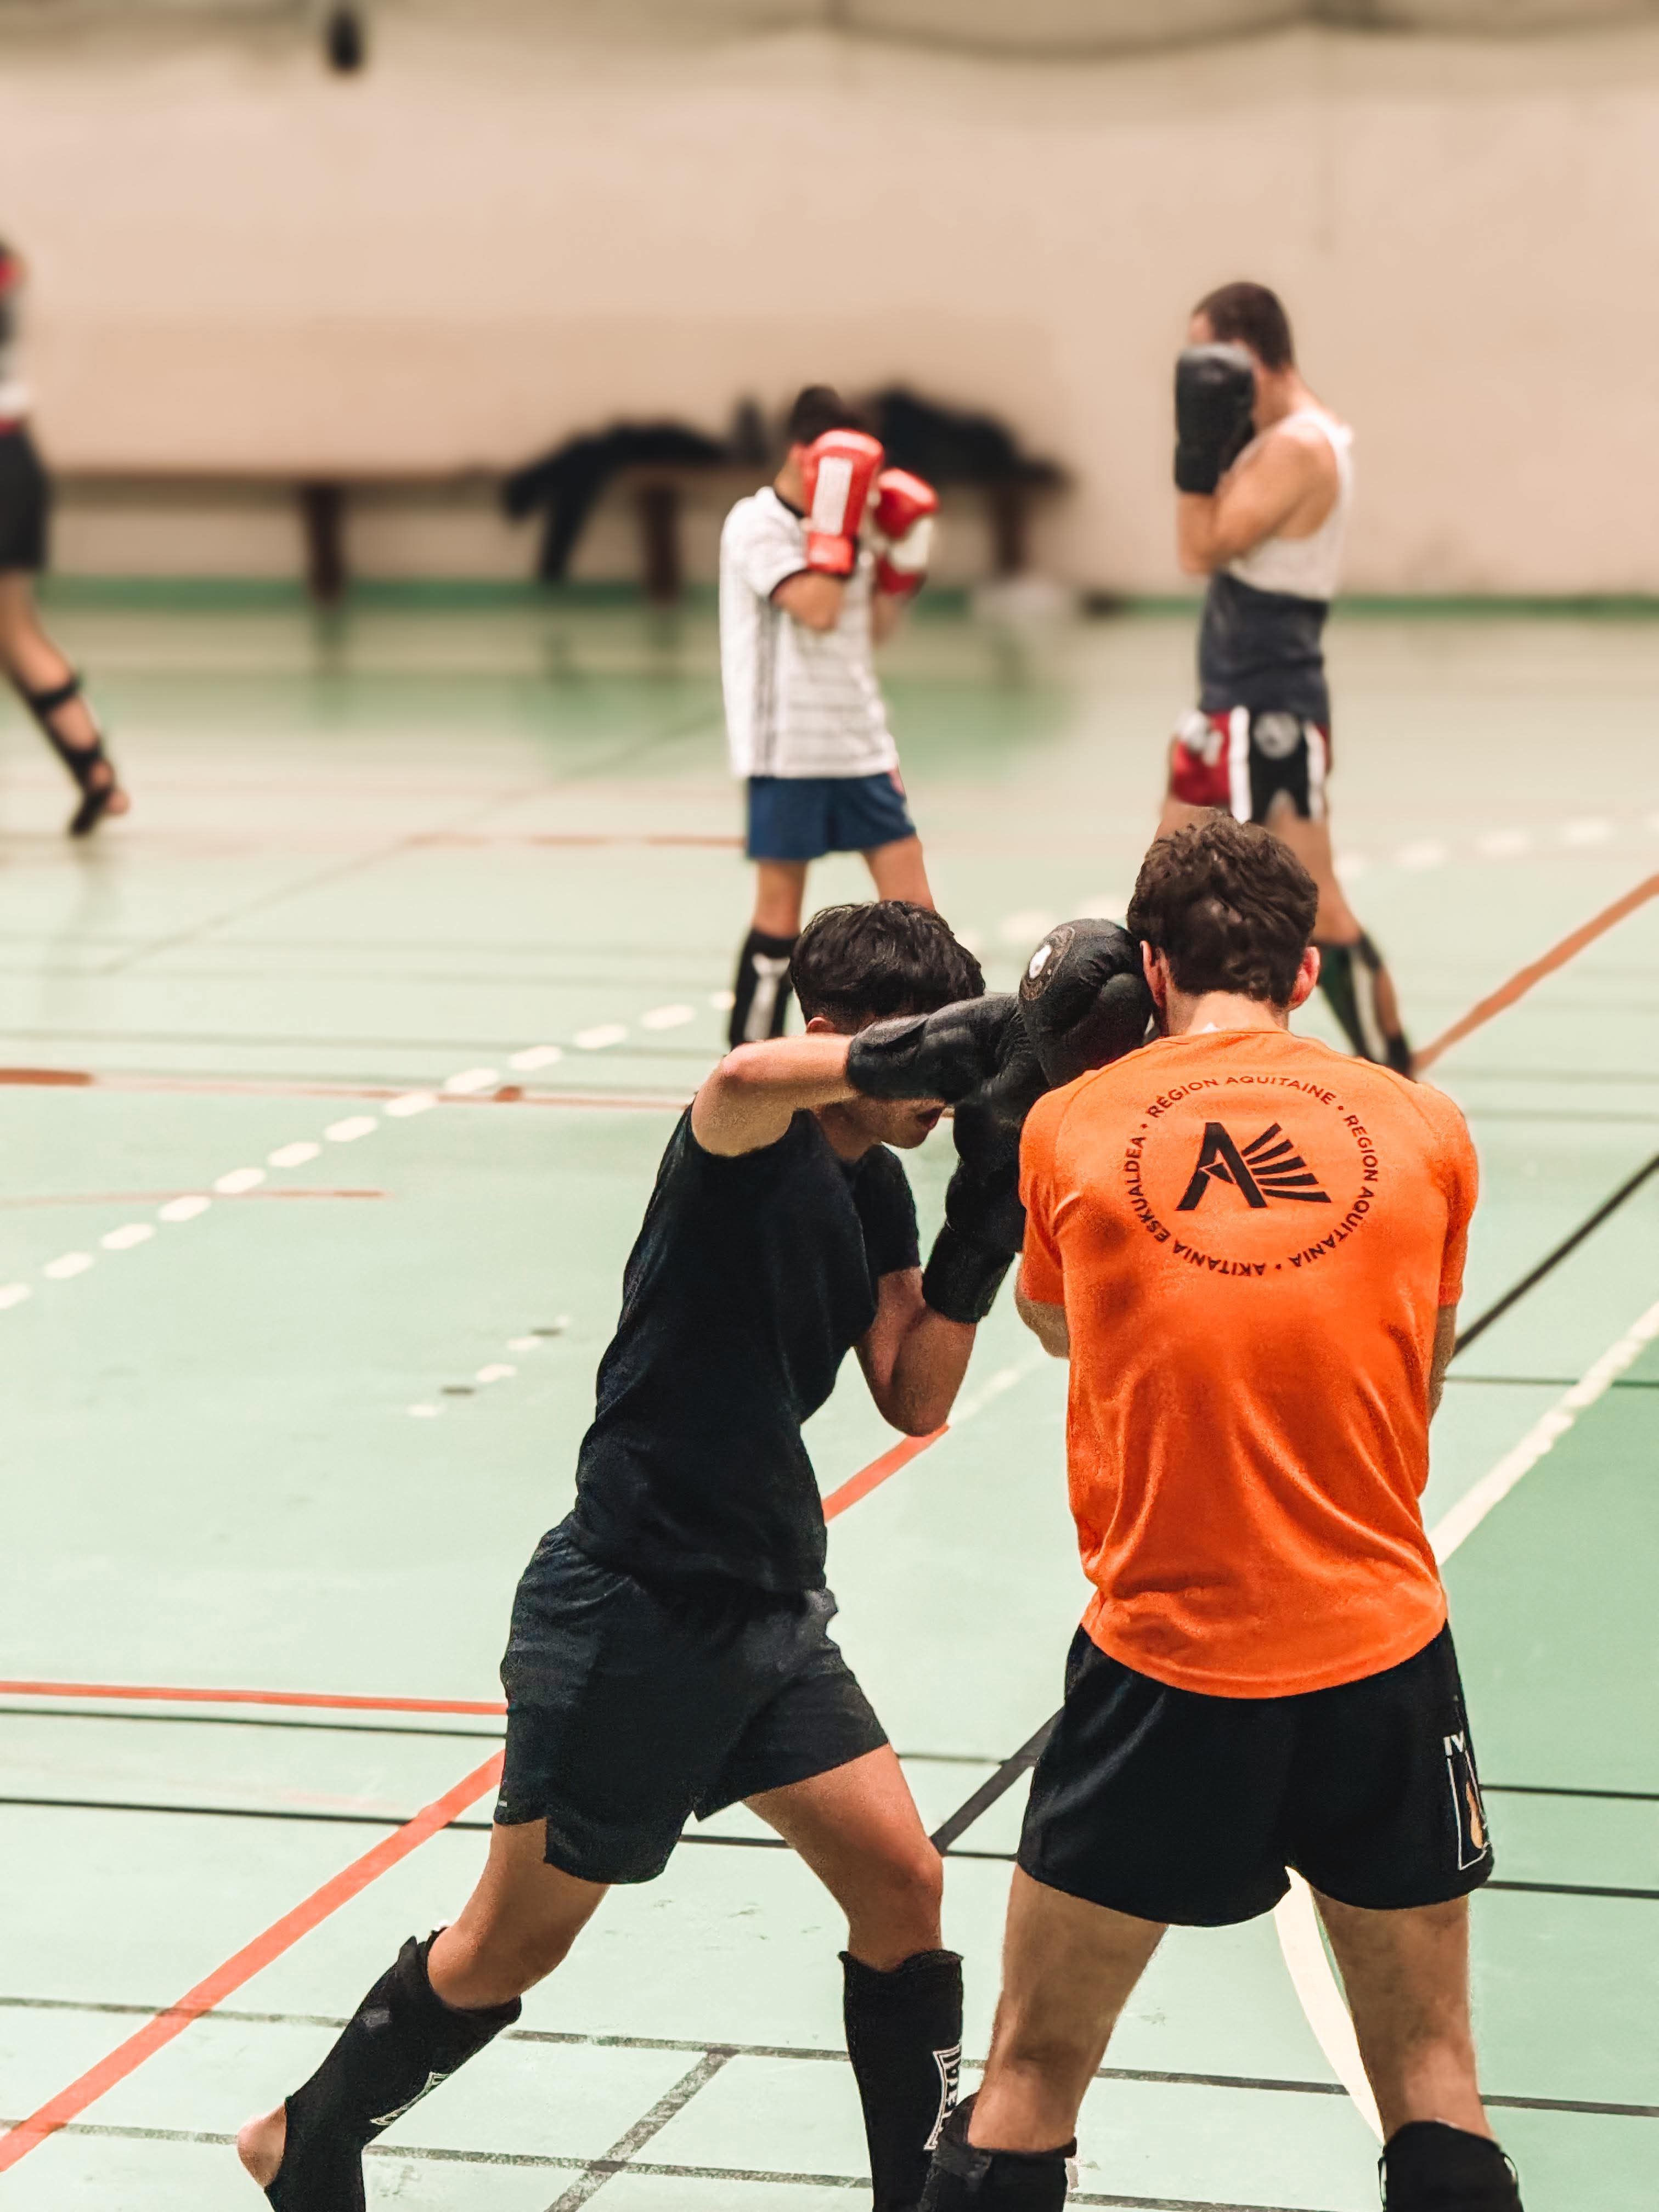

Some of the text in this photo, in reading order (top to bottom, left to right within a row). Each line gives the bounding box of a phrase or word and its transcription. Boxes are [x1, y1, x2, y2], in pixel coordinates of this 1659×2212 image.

[1226, 1076, 1337, 1105] AQUITAINE
[1124, 1137, 1266, 1276] AKITANIA ESKUALDEA
[1288, 1114, 1378, 1267] REGION AQUITANIA
